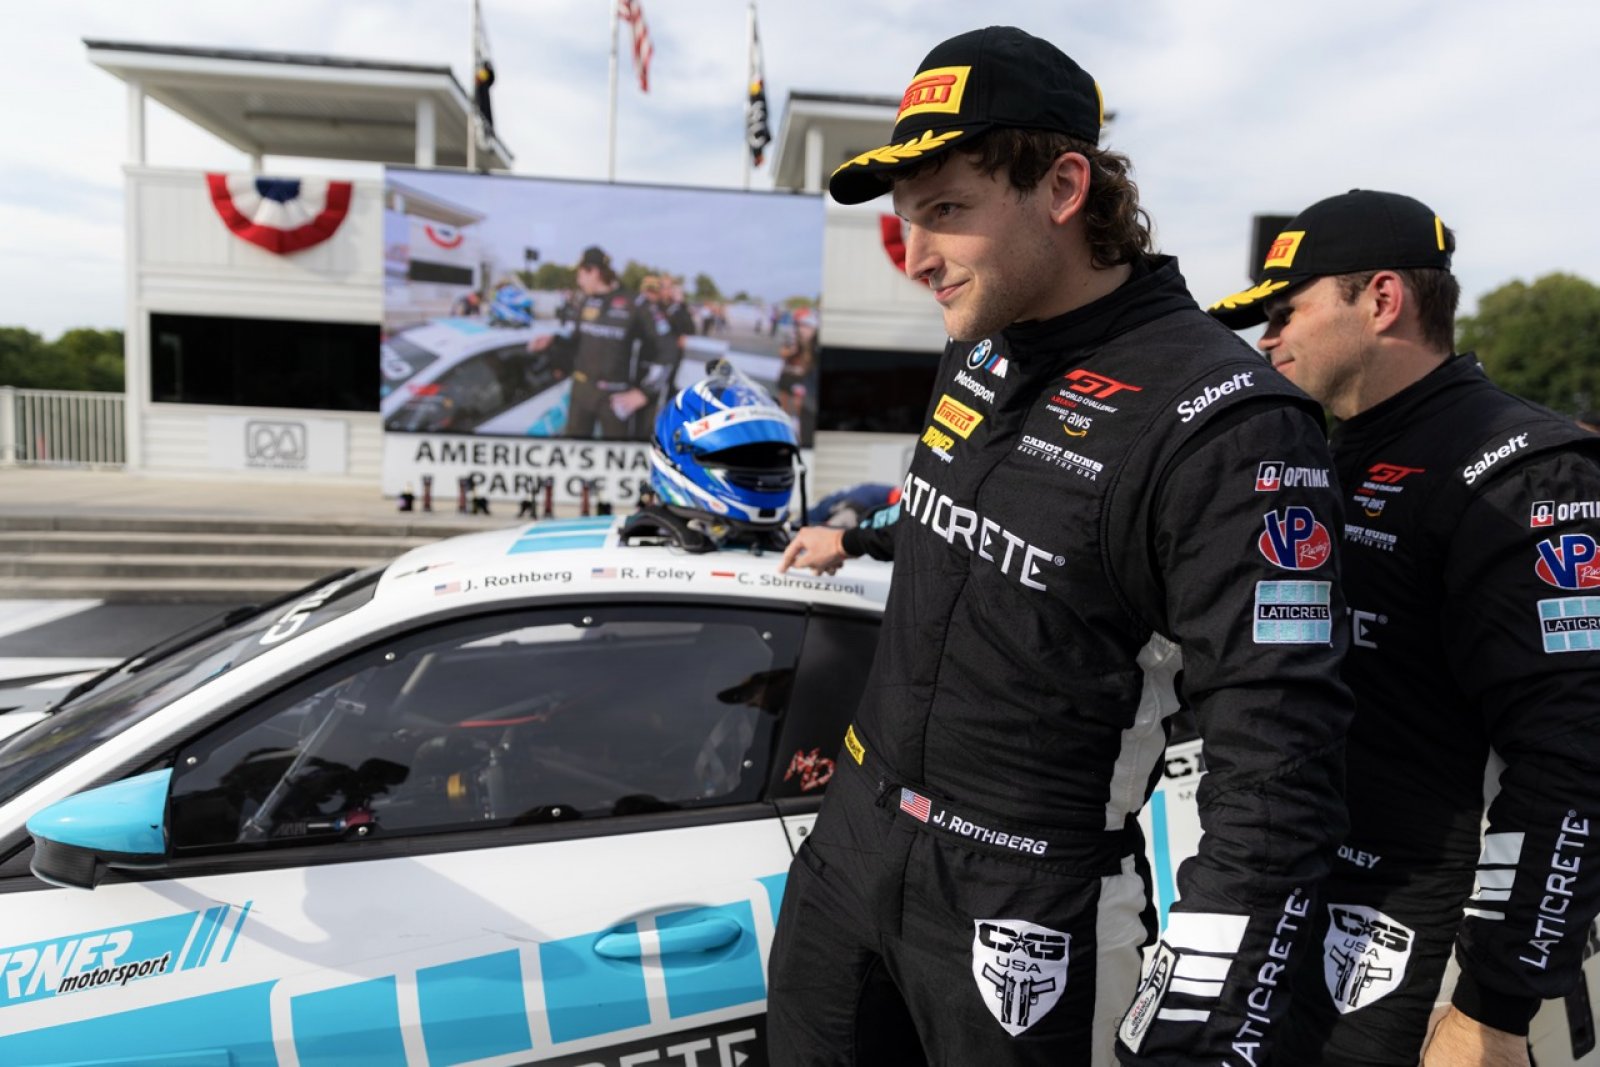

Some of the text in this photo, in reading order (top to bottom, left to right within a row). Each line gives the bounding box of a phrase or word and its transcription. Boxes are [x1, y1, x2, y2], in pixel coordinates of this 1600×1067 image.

[1177, 372, 1255, 423] Sabelt
[937, 400, 975, 432] PIRELLI
[1067, 412, 1093, 430] aws
[416, 440, 594, 469] AMERICA'S
[1022, 435, 1104, 472] CABOT GUNS
[1463, 432, 1529, 485] Sabelt
[1076, 465, 1097, 481] USA
[1283, 467, 1330, 488] OPTIMA
[1557, 501, 1600, 521] OPTI
[1264, 506, 1315, 569] VP
[1536, 533, 1596, 589] VP
[464, 570, 573, 592] J. Rothberg
[621, 567, 695, 581] R. Foley
[738, 572, 755, 585] C.
[1260, 606, 1329, 619] LATICRETE
[1546, 618, 1600, 632] LATICR
[933, 810, 1049, 855] J. ROTHBERG
[1343, 938, 1380, 960] USA
[57, 952, 170, 994] motorsport
[996, 955, 1042, 974] USA
